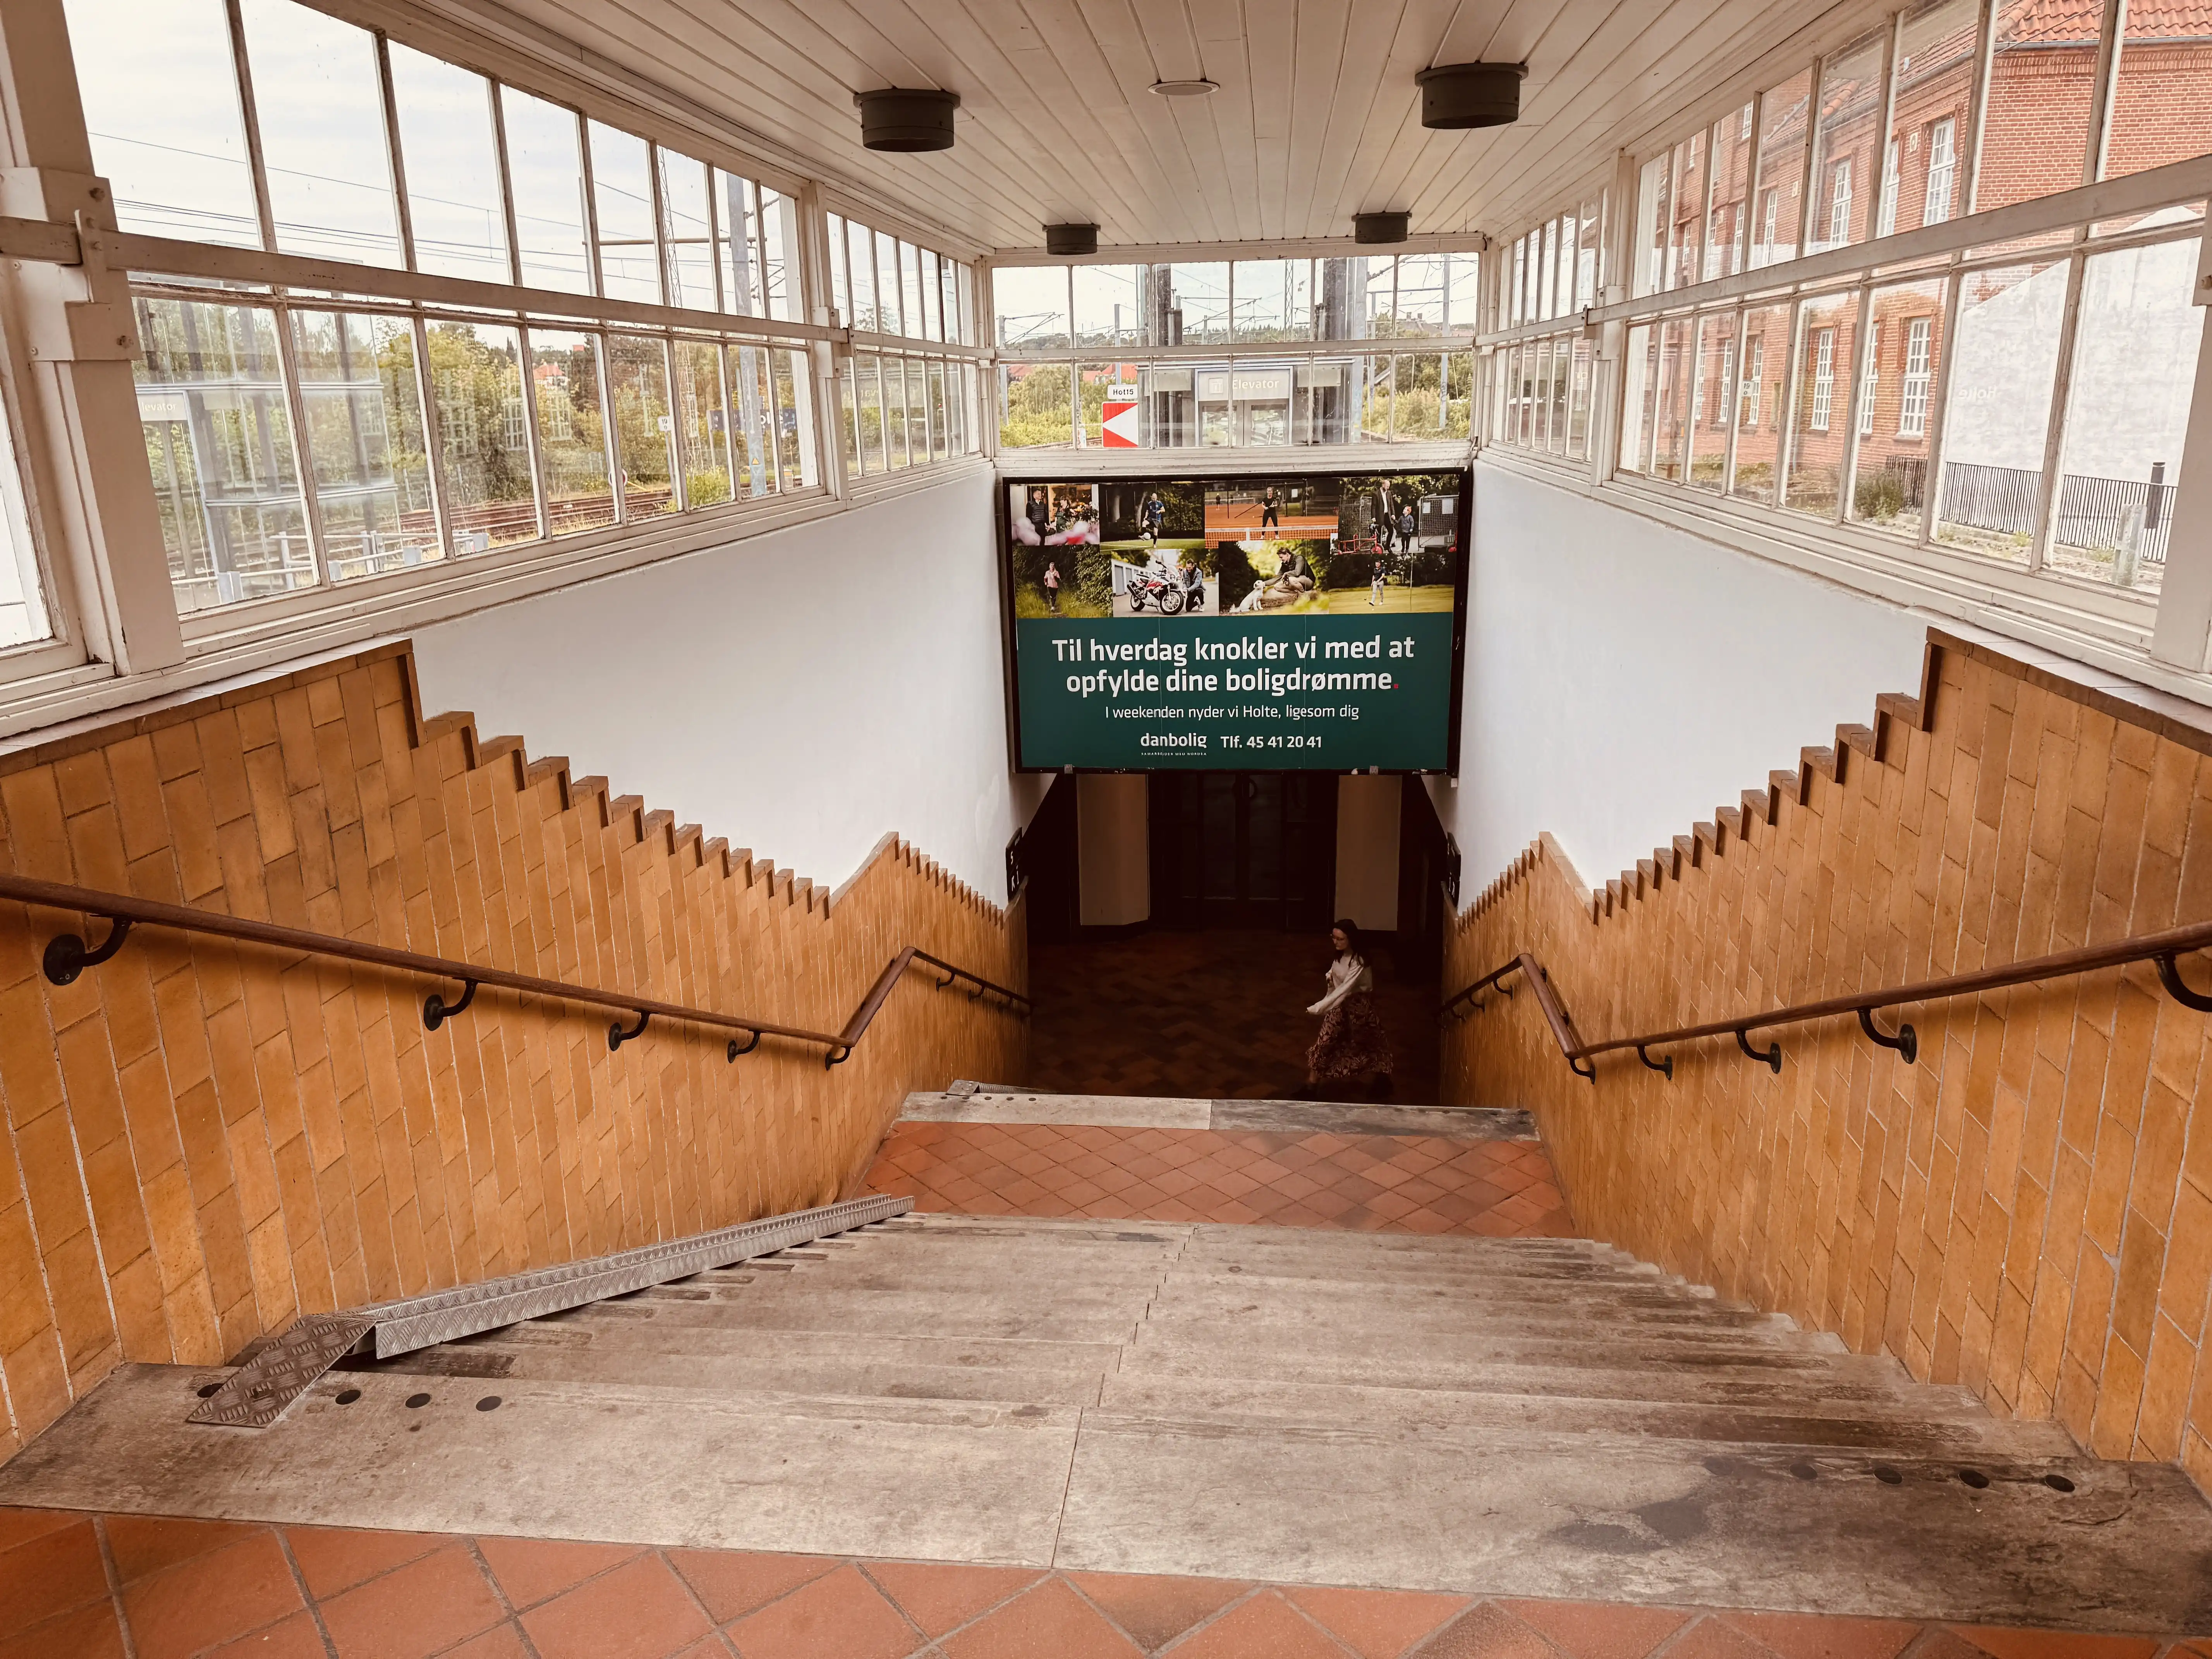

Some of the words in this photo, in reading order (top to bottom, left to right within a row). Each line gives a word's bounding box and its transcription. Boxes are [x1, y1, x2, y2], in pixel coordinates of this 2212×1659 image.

[1232, 378, 1279, 390] Elevator
[141, 402, 177, 412] levator
[1051, 638, 1082, 661] Til
[1090, 637, 1188, 666] hverdag
[1195, 635, 1288, 661] knokler
[1294, 635, 1316, 659] vi
[1325, 634, 1381, 659] med
[1388, 636, 1415, 658] at
[1066, 669, 1159, 699] opfylde
[1166, 668, 1218, 692] dine
[1226, 667, 1399, 697] boligdrømme.
[1105, 706, 1109, 719] I
[1112, 705, 1184, 719] weekenden
[1188, 705, 1225, 721] nyder
[1227, 705, 1239, 718] vi
[1243, 704, 1281, 719] Holte,
[1286, 704, 1335, 721] ligesom
[1339, 704, 1360, 720] dig
[1140, 732, 1207, 749] danbolig
[1220, 735, 1243, 749] Tlf.
[1246, 736, 1264, 749] 45
[1267, 736, 1283, 748] 41
[1286, 735, 1304, 748] 20
[1306, 736, 1322, 748] 41
